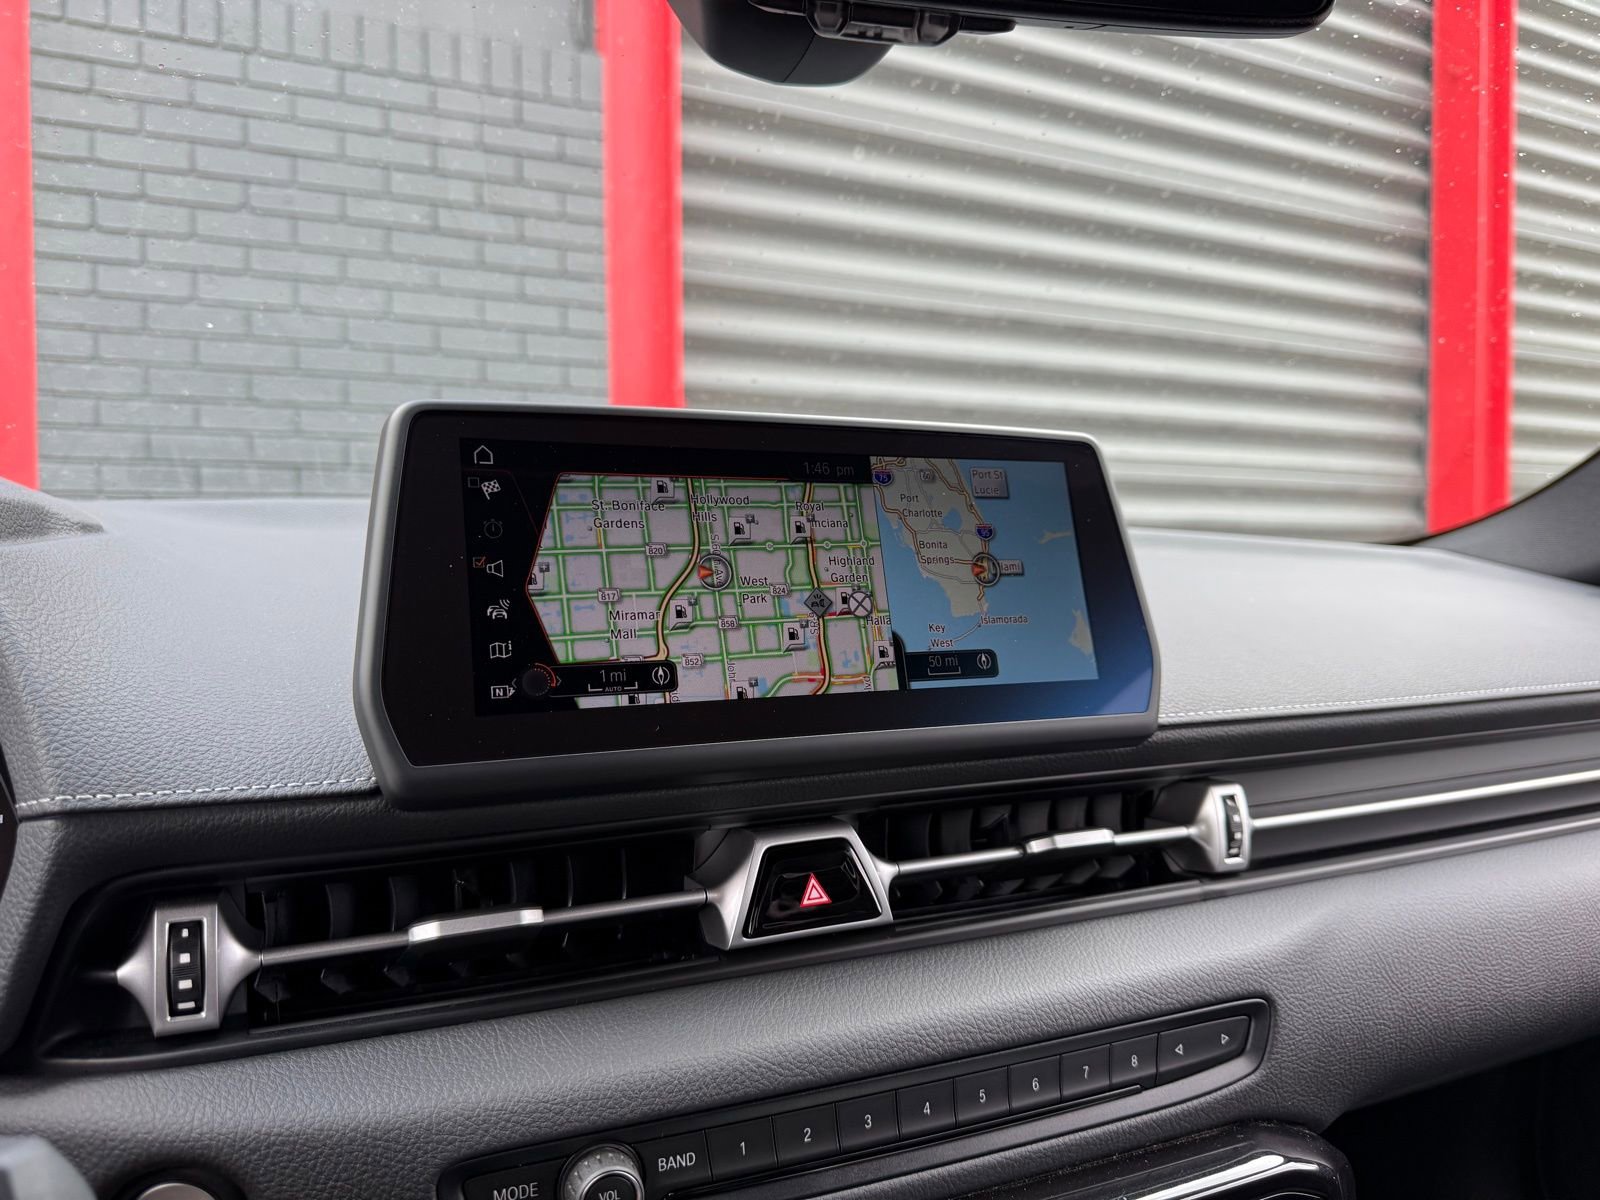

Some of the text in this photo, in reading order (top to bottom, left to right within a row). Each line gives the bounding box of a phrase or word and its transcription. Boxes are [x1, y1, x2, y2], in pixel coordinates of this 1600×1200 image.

[803, 462, 855, 476] 1:46 pm
[972, 470, 1004, 480] Port St
[974, 486, 999, 495] Lucie
[691, 494, 750, 506] Hollywood
[900, 493, 919, 503] Port
[591, 500, 665, 512] St. Boniface
[795, 501, 824, 513] Royal
[692, 511, 718, 522] Hills
[902, 508, 943, 518] Charlotte
[593, 518, 645, 529] Gardens
[648, 546, 664, 555] 820
[918, 540, 948, 550] Bonita
[828, 555, 875, 568] Highland
[921, 555, 955, 566] Springs
[740, 576, 769, 587] West
[831, 573, 868, 584] Garden
[601, 592, 616, 600] 817
[772, 586, 786, 595] 824
[742, 593, 768, 604] Park
[609, 610, 661, 621] Miramar
[980, 615, 1029, 625] Islamorada
[721, 619, 735, 628] 858
[928, 623, 946, 633] Key
[611, 629, 638, 640] Mall
[930, 639, 953, 648] West
[684, 657, 700, 666] 852
[928, 655, 959, 667] 50 mi
[610, 668, 627, 681] mi
[1131, 1054, 1138, 1067] 8
[1083, 1065, 1089, 1079] 7
[1032, 1077, 1040, 1091] 6
[979, 1089, 987, 1103] 5
[922, 1102, 931, 1116] 4
[864, 1114, 872, 1129] 3
[803, 1127, 812, 1143] 2
[739, 1141, 746, 1156] 1
[658, 1151, 696, 1173] BAND
[493, 1182, 540, 1200] MODE
[598, 1190, 622, 1200] VOL
